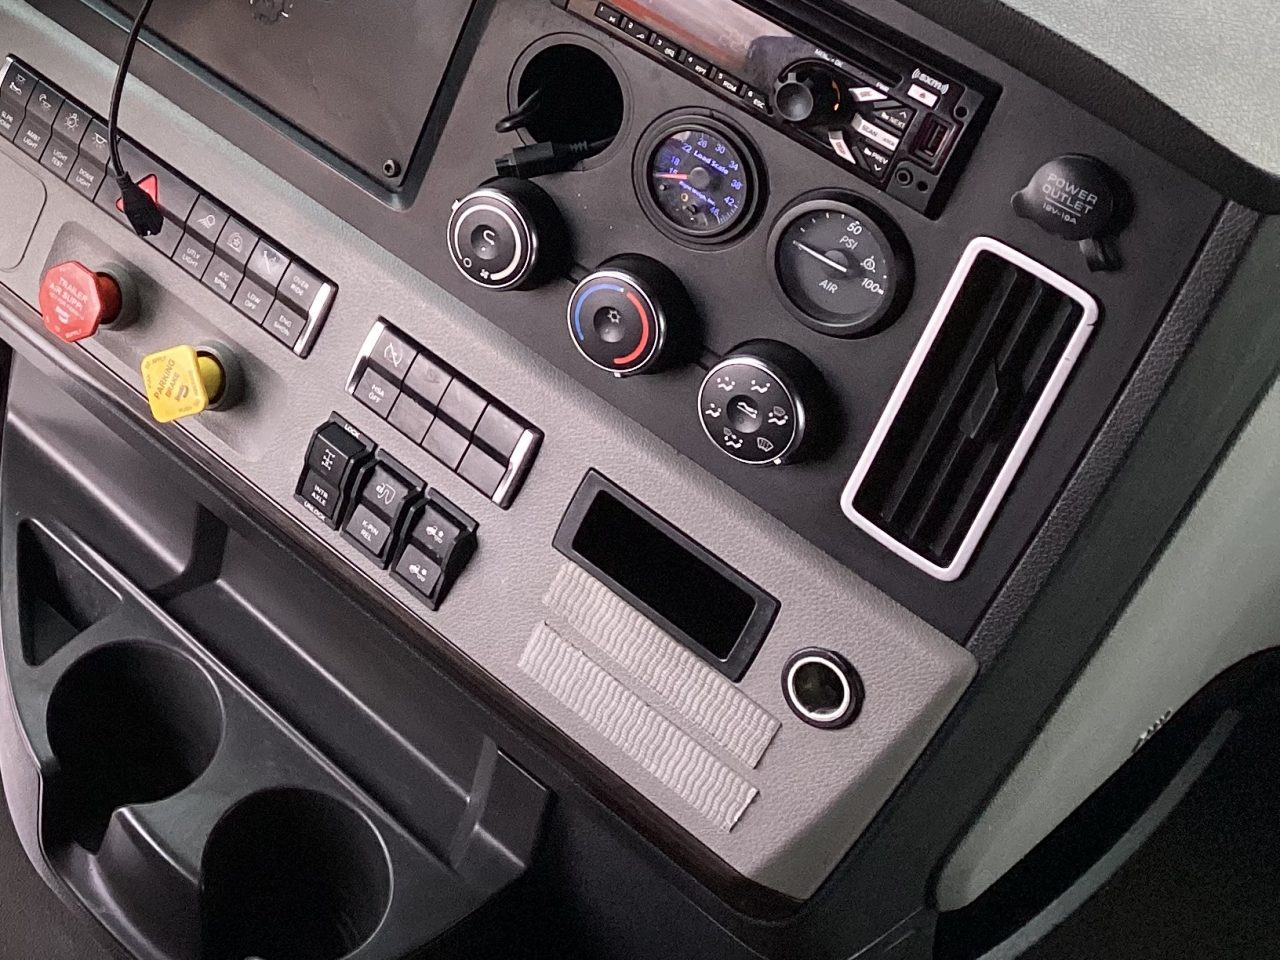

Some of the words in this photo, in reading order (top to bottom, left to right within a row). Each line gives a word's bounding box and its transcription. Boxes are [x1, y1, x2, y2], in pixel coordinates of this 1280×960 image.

[23, 136, 38, 149] LIGHT
[682, 143, 692, 154] 22
[715, 143, 726, 154] 30
[51, 156, 64, 168] TEST
[53, 148, 68, 162] LIGHT
[693, 149, 712, 165] Load
[710, 160, 729, 175] Scale
[871, 151, 889, 165] PREV
[728, 160, 739, 171] 34
[75, 175, 91, 189] LIGHT
[730, 178, 741, 191] 38
[1047, 172, 1098, 205] POWER
[724, 195, 735, 207] 42
[1042, 183, 1094, 214] OUTLET
[846, 221, 862, 235] 50
[840, 235, 858, 250] PSI
[182, 255, 199, 268] LIGHT
[294, 275, 310, 290] OVER
[819, 279, 839, 294] AIR
[861, 277, 879, 293] 100
[59, 276, 88, 304] TRAILER
[153, 358, 176, 400] PARKING
[164, 371, 181, 398] BRAKE
[371, 383, 385, 397] HSA
[368, 392, 381, 404] OFF
[344, 423, 361, 439] LOCK
[311, 491, 327, 507] AXLE
[303, 501, 326, 522] UNLOCK
[360, 529, 372, 542] REL
